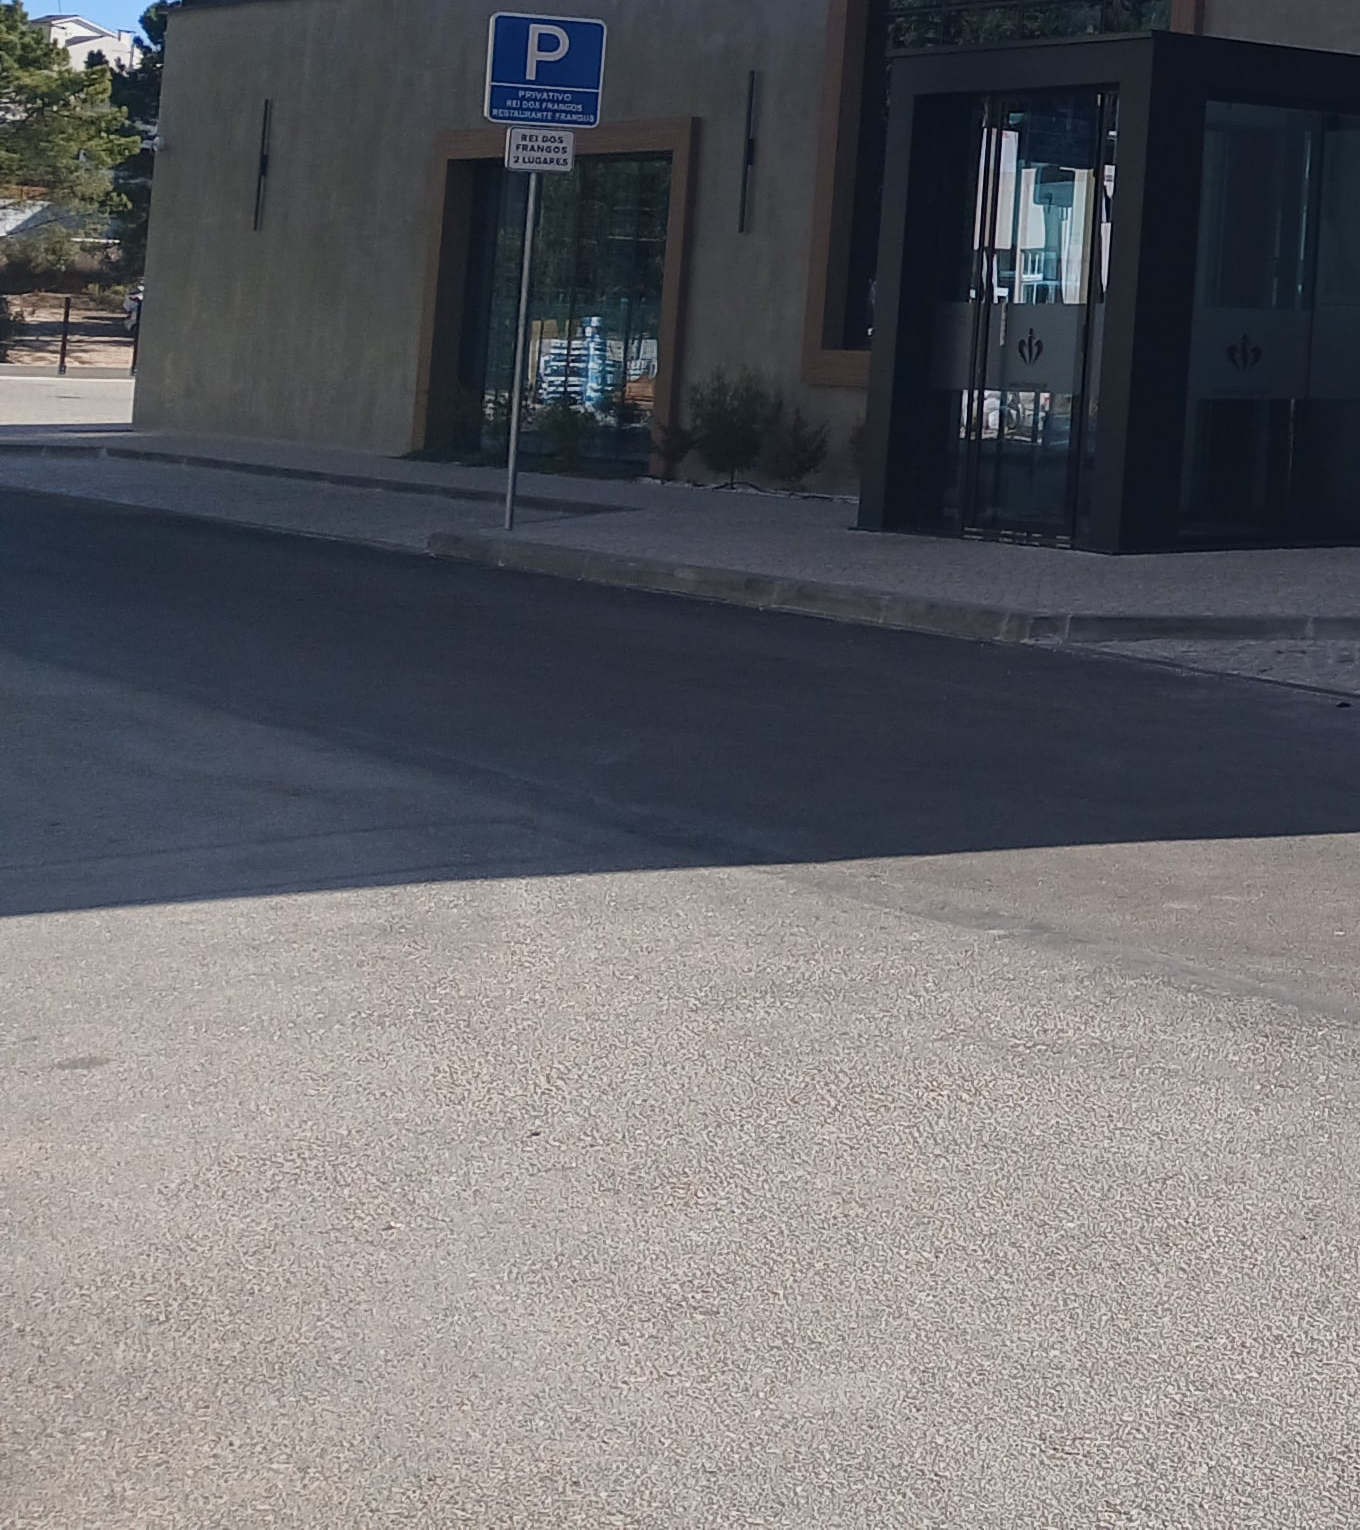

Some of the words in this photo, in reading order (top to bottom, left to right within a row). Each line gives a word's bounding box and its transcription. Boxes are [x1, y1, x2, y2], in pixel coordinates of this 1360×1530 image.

[525, 23, 570, 81] P
[518, 90, 572, 101] PRIVATIVO
[506, 99, 520, 109] REI
[522, 100, 540, 109] DOS
[542, 101, 583, 112] FRANGOS
[521, 134, 538, 143] REI
[541, 135, 564, 144] DOS
[515, 144, 568, 154] FRANGOS
[513, 156, 520, 164] 2
[522, 156, 569, 167] LUGARES
